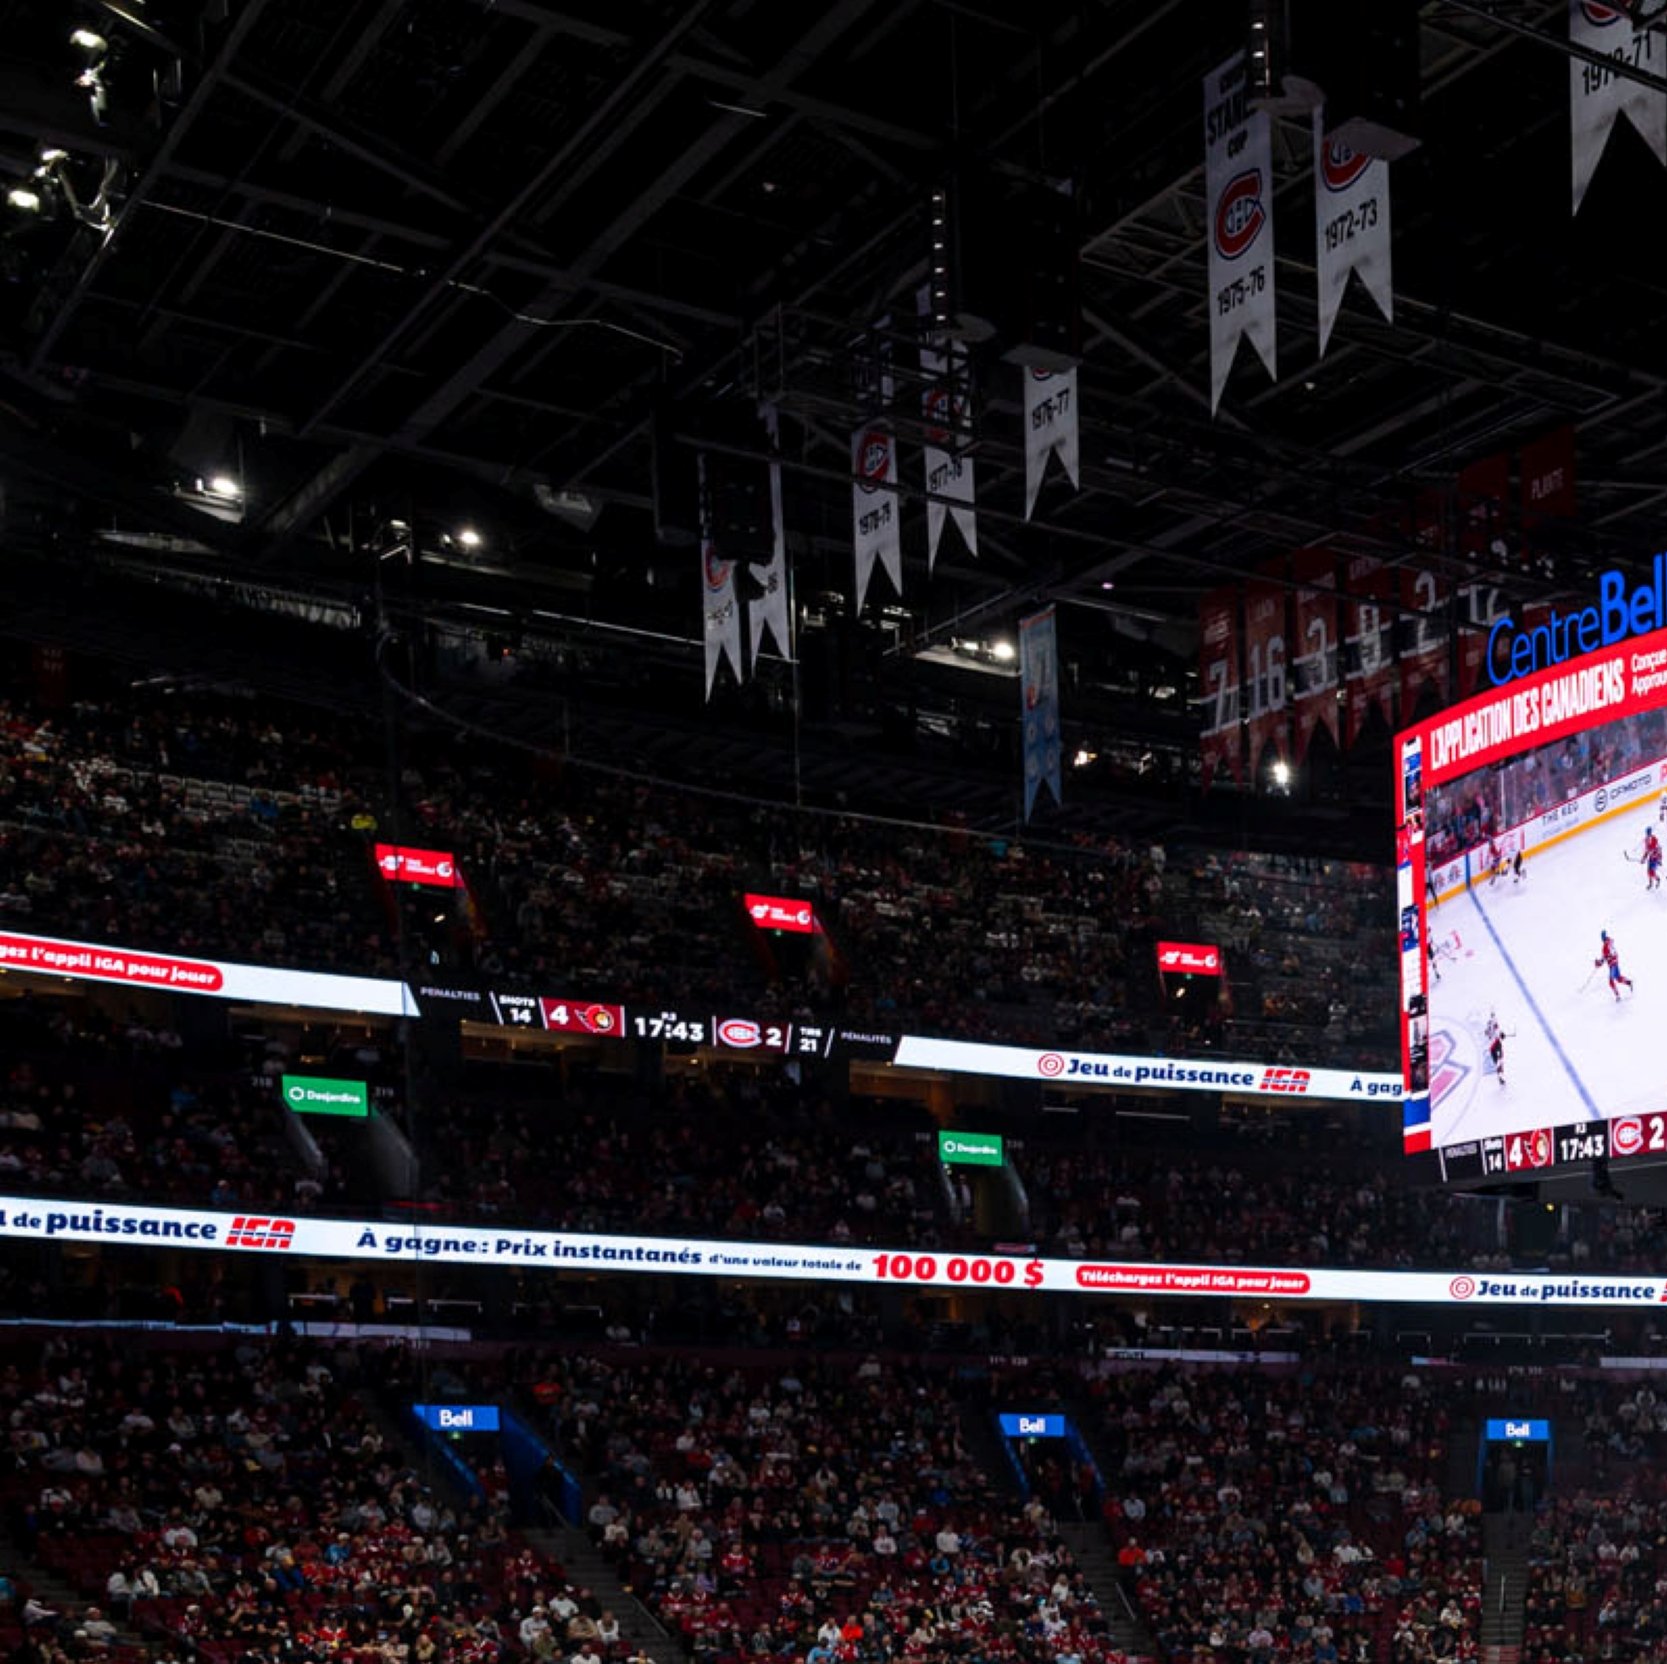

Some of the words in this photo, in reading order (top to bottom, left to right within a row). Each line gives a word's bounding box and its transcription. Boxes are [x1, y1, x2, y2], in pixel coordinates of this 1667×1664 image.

[1324, 199, 1379, 252] 1972-73
[1217, 265, 1266, 316] 1975-76
[1251, 635, 1286, 709] 16
[1630, 646, 1666, 674] Conçue
[1429, 699, 1514, 771] L'APPLICATION
[1516, 689, 1543, 741] DES
[1544, 658, 1626, 731] CANADIENS
[420, 986, 480, 1000] PENALTIES
[634, 1016, 704, 1042] 17:43
[1067, 1057, 1109, 1080] Jeu
[1135, 1062, 1254, 1087] puissance
[1561, 1135, 1604, 1161] 17:43
[1650, 1118, 1664, 1150] 2
[495, 1239, 546, 1257] Prix
[553, 1240, 701, 1265] instantanés
[873, 1254, 937, 1281] 100
[947, 1258, 1013, 1284] 000
[1541, 1280, 1655, 1301] puissance
[440, 1409, 472, 1427] Bell
